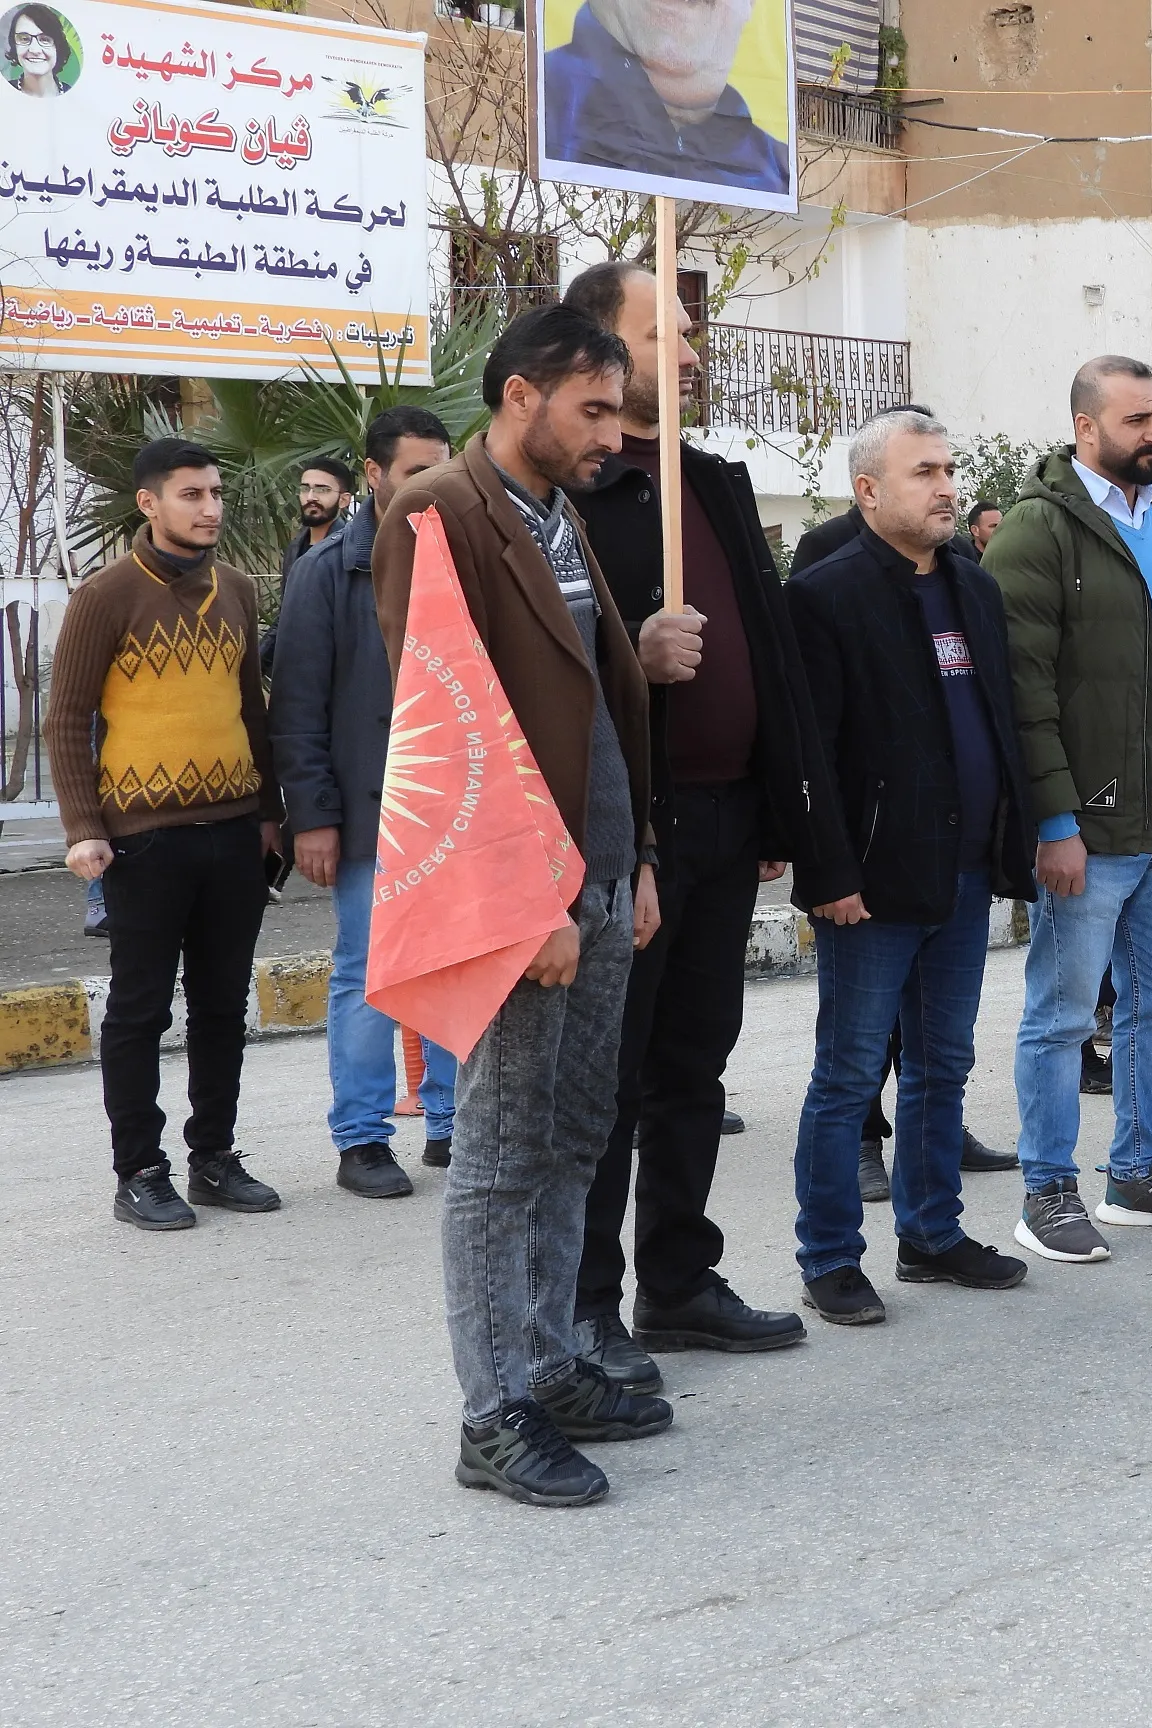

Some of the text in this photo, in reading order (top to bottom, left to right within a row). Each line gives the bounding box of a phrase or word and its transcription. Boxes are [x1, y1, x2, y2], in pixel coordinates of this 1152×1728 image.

[101, 33, 314, 97] مركز الشهيدة
[108, 98, 236, 155] كوباني
[0, 160, 407, 232] لحركة الطلبة الديمقراطيين
[253, 243, 338, 279] منطقة
[345, 252, 372, 294] في
[94, 305, 154, 331] ثقافية
[174, 311, 241, 338] تعليمية
[1104, 795, 1114, 805] 11
